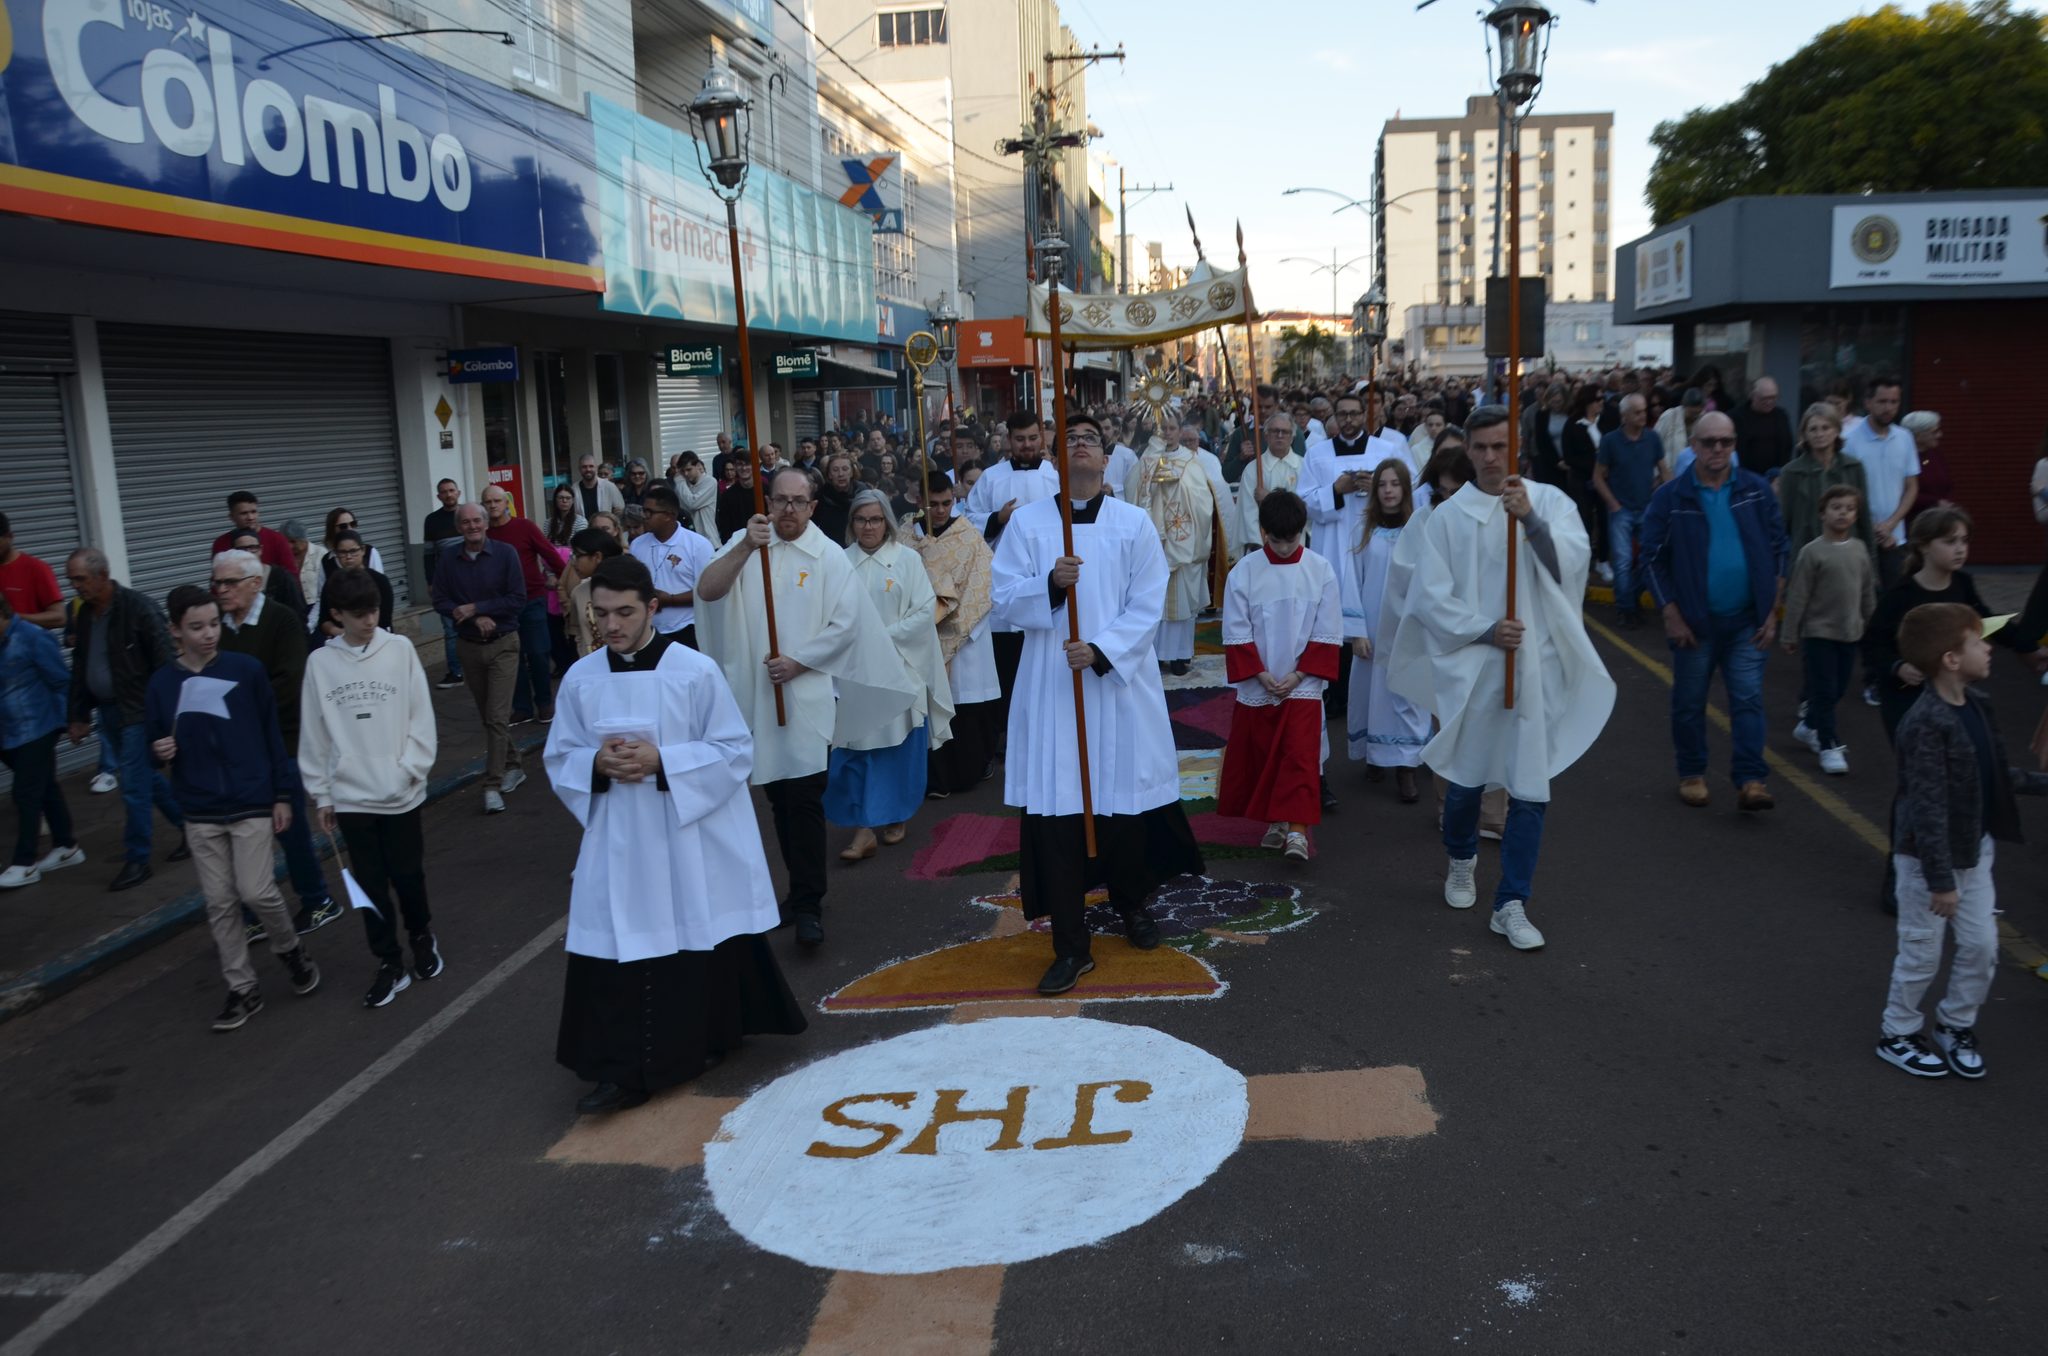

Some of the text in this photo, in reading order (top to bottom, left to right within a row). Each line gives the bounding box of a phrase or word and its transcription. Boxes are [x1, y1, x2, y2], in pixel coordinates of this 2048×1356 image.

[42, 0, 472, 212] Colombo
[648, 197, 738, 268] Farmáci
[1925, 215, 2011, 240] BRIGADA
[1925, 240, 2009, 264] MILITAR
[463, 359, 514, 372] Colombo
[326, 681, 365, 701] SPORTS
[334, 691, 388, 706] ATHLETIC
